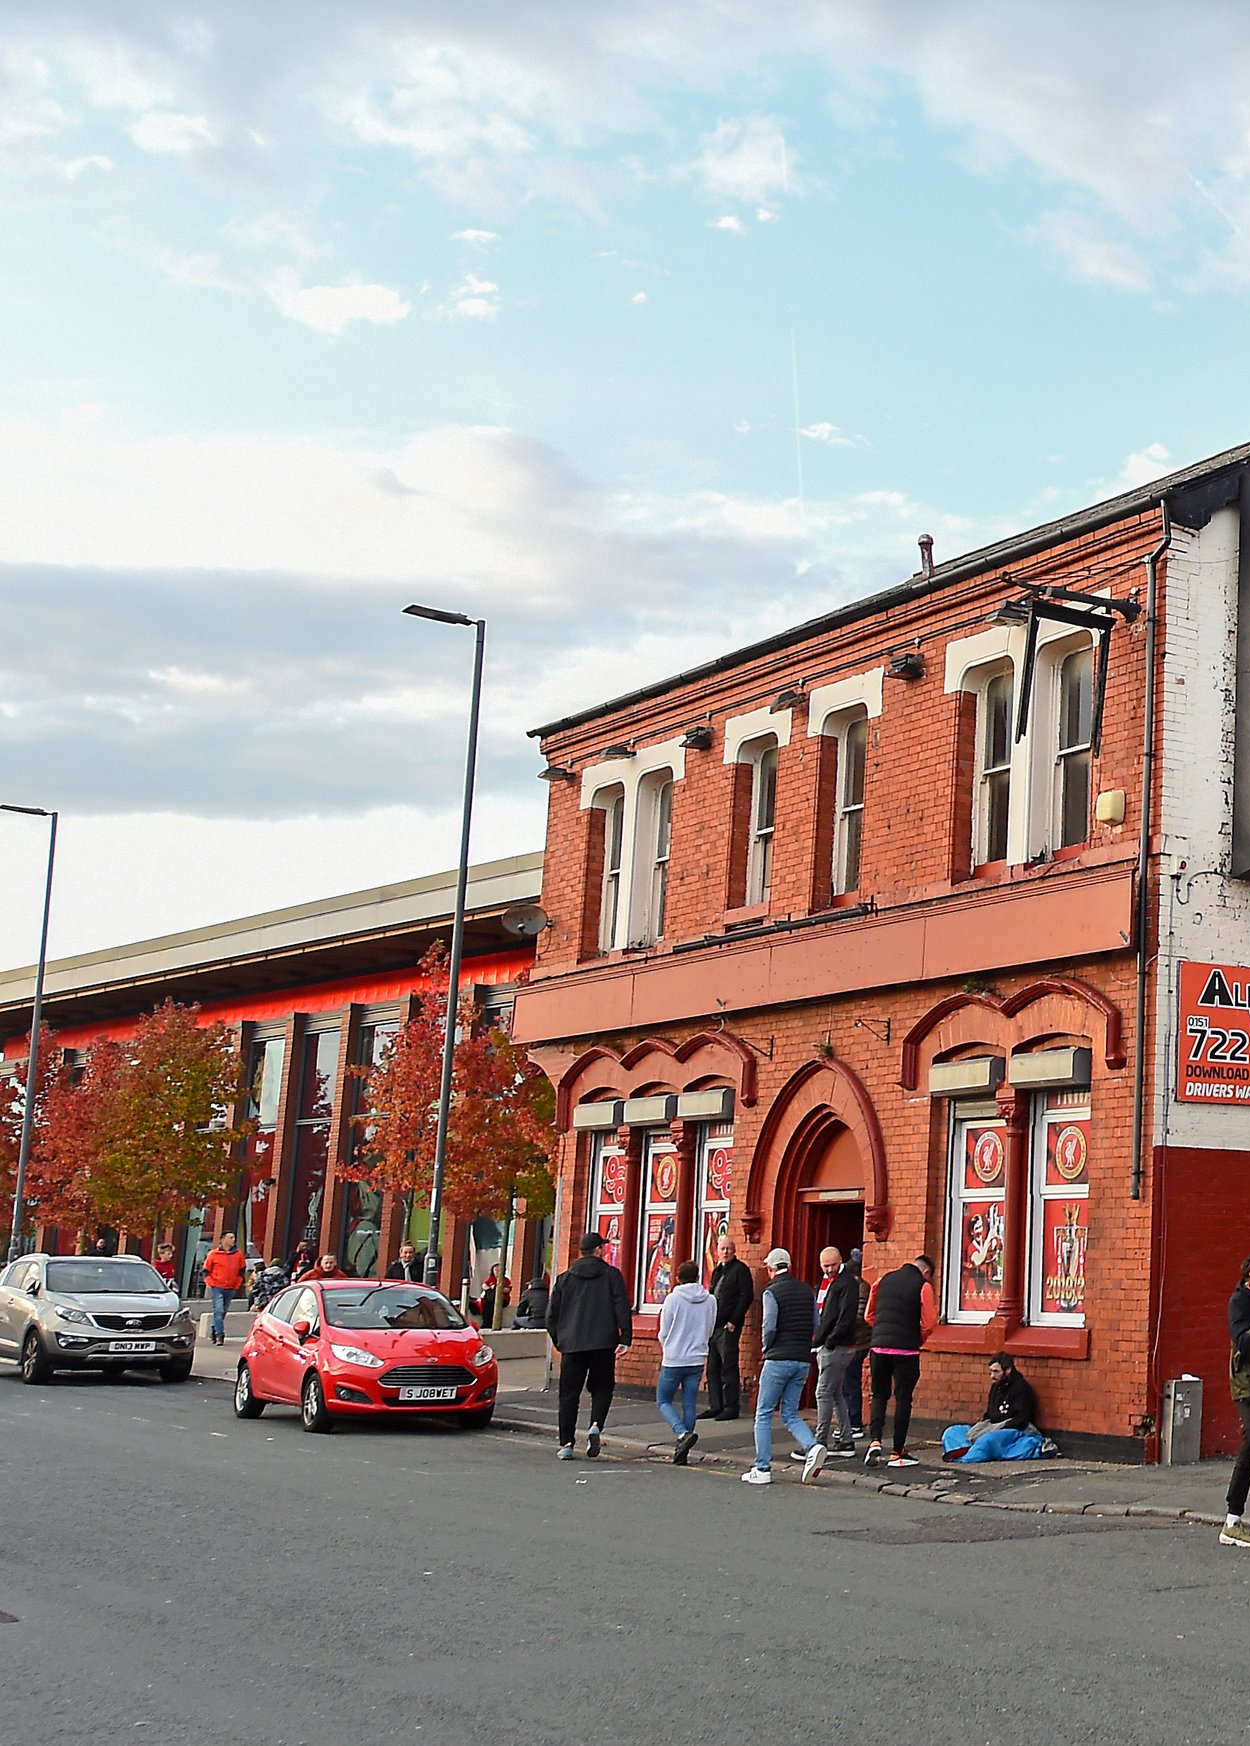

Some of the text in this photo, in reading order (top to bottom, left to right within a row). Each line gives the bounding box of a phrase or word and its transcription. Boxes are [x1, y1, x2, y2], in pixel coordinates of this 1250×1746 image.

[1187, 1016, 1208, 1028] 0151
[1187, 1028, 1249, 1064] 722
[1186, 1065, 1249, 1081] DOWNLOAD
[1185, 1082, 1234, 1098] DRIVERS
